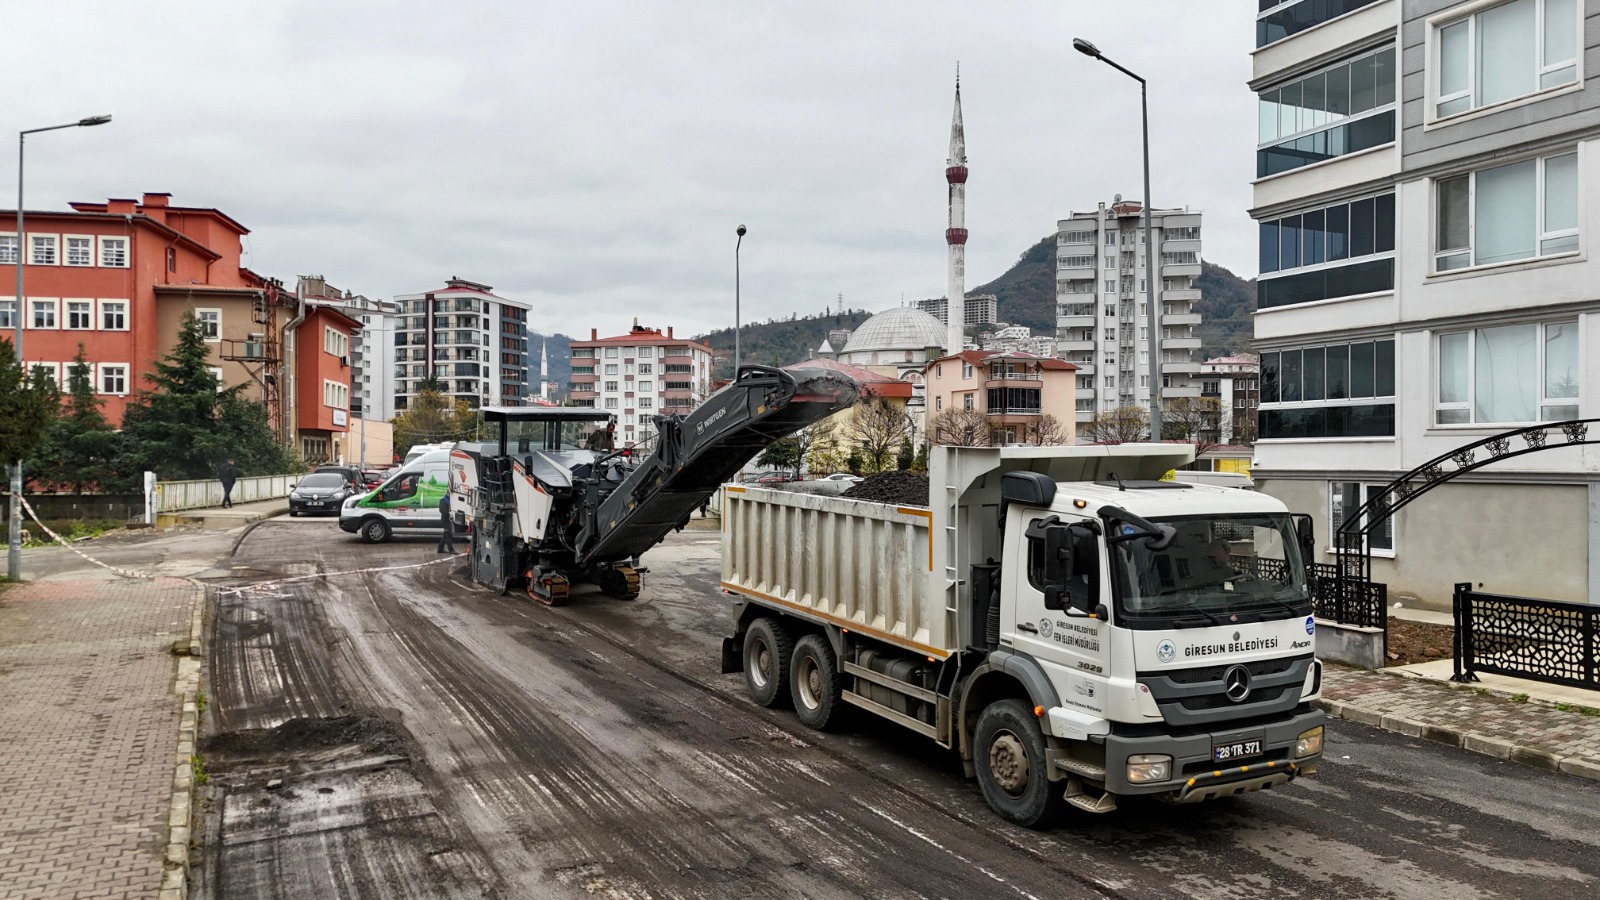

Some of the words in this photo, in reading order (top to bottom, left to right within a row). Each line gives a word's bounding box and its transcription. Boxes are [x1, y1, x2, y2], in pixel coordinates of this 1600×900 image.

[703, 406, 727, 428] WIRTGEN
[1056, 620, 1074, 631] GİRESUN
[1074, 624, 1099, 637] BELEDİYESİ
[1053, 632, 1062, 643] FEN
[1184, 643, 1226, 657] GİRESUN
[1228, 635, 1278, 653] BELEDİYESİ
[1077, 661, 1103, 674] 3029
[1219, 746, 1230, 759] 28
[1231, 744, 1243, 757] TR
[1244, 741, 1260, 754] 371
